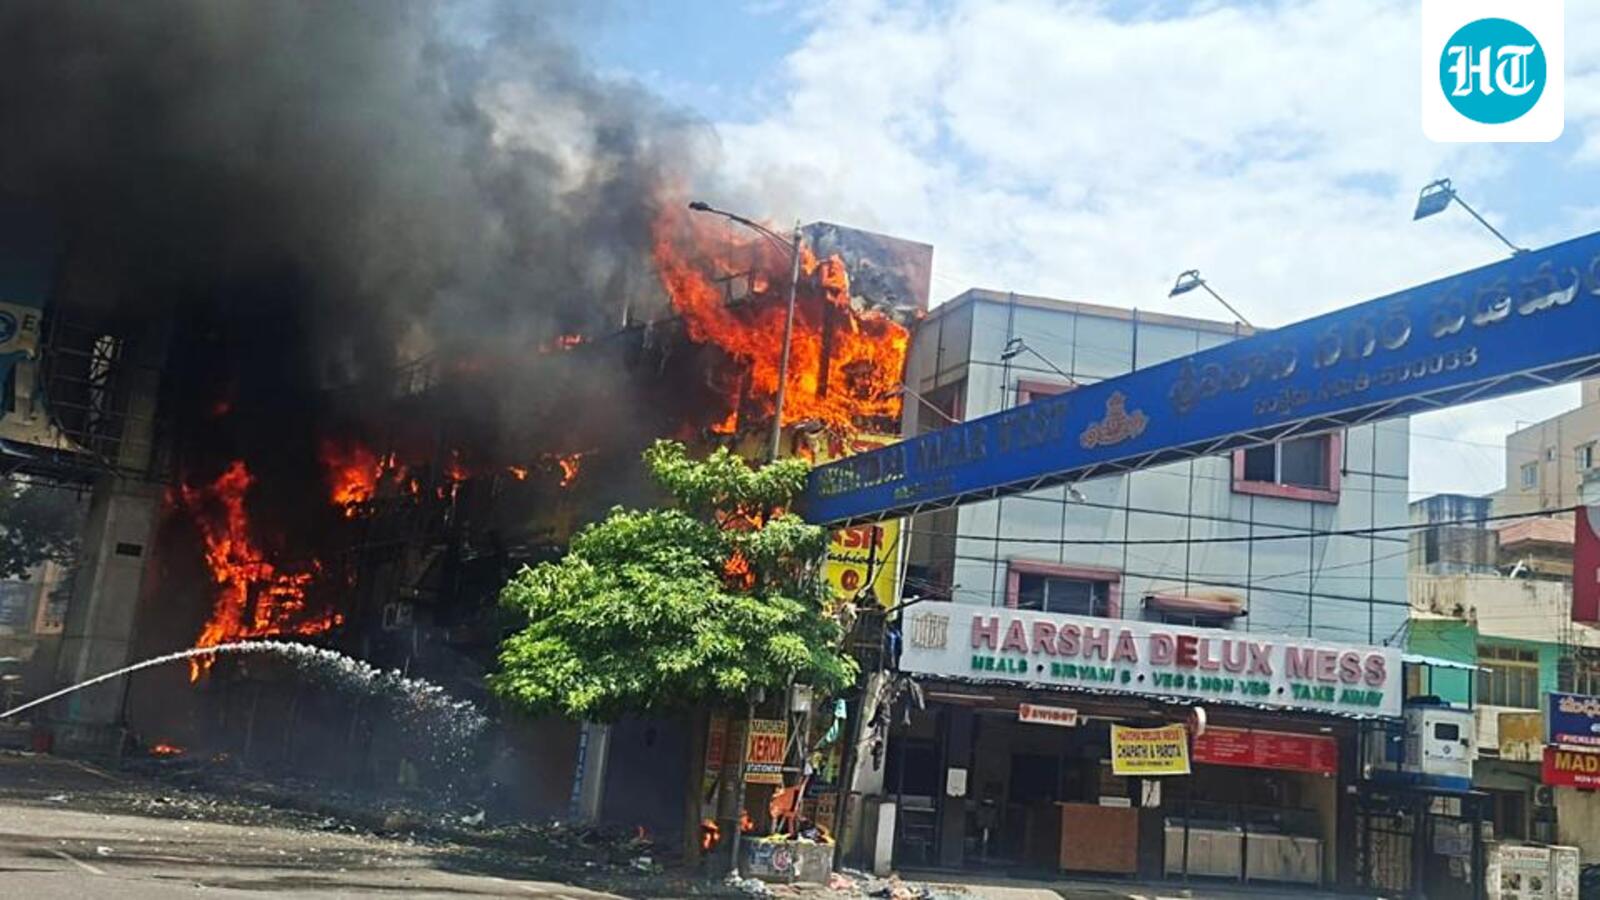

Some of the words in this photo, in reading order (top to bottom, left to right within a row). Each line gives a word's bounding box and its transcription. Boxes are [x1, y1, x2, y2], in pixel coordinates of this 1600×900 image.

[971, 615, 1138, 664] HARSHA
[1149, 632, 1273, 677] DELUX
[1285, 646, 1387, 687] MESS
[971, 655, 1028, 675] MEALS
[1152, 671, 1185, 689] VEG
[1291, 683, 1335, 703] TAKE
[1338, 688, 1384, 707] AWAY
[748, 734, 787, 763] XEROX
